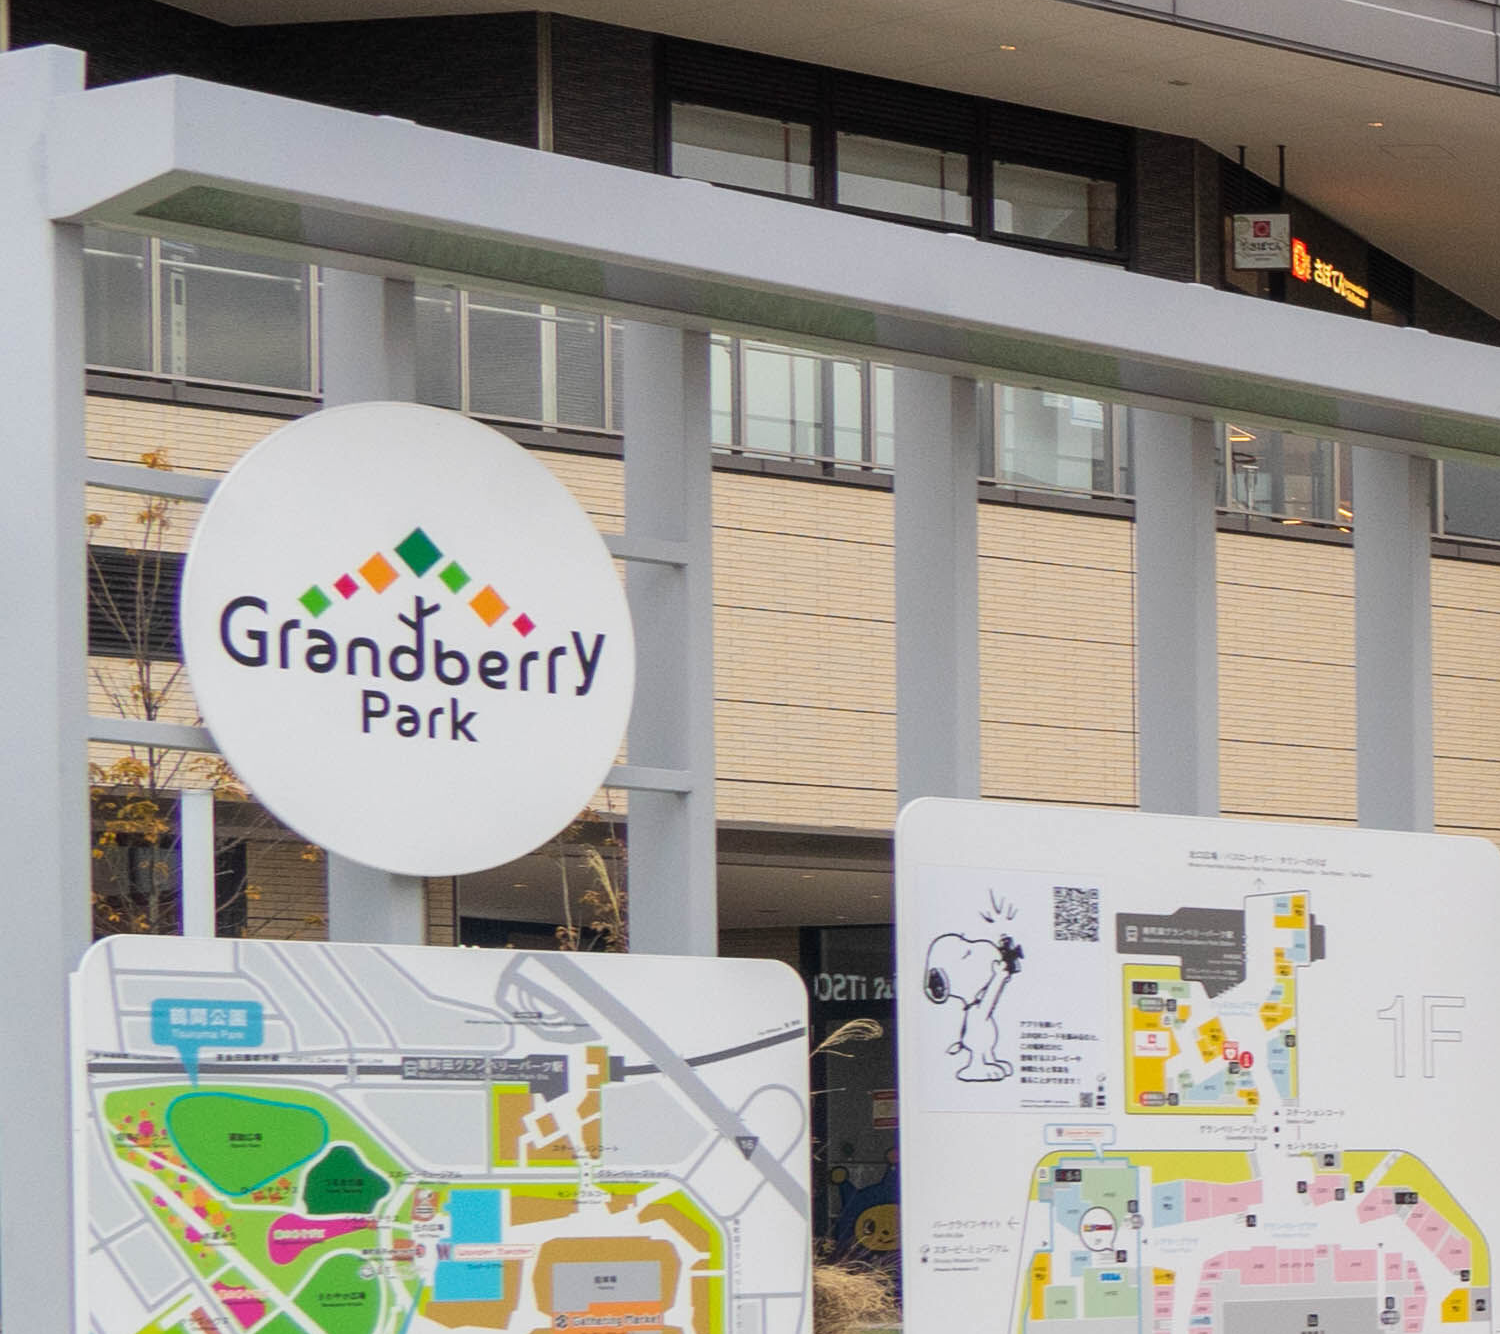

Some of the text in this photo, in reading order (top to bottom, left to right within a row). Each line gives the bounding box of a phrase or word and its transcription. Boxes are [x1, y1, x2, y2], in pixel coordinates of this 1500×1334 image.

[219, 595, 607, 696] Grandberry
[361, 690, 479, 742] Park
[1377, 994, 1466, 1079] 1F
